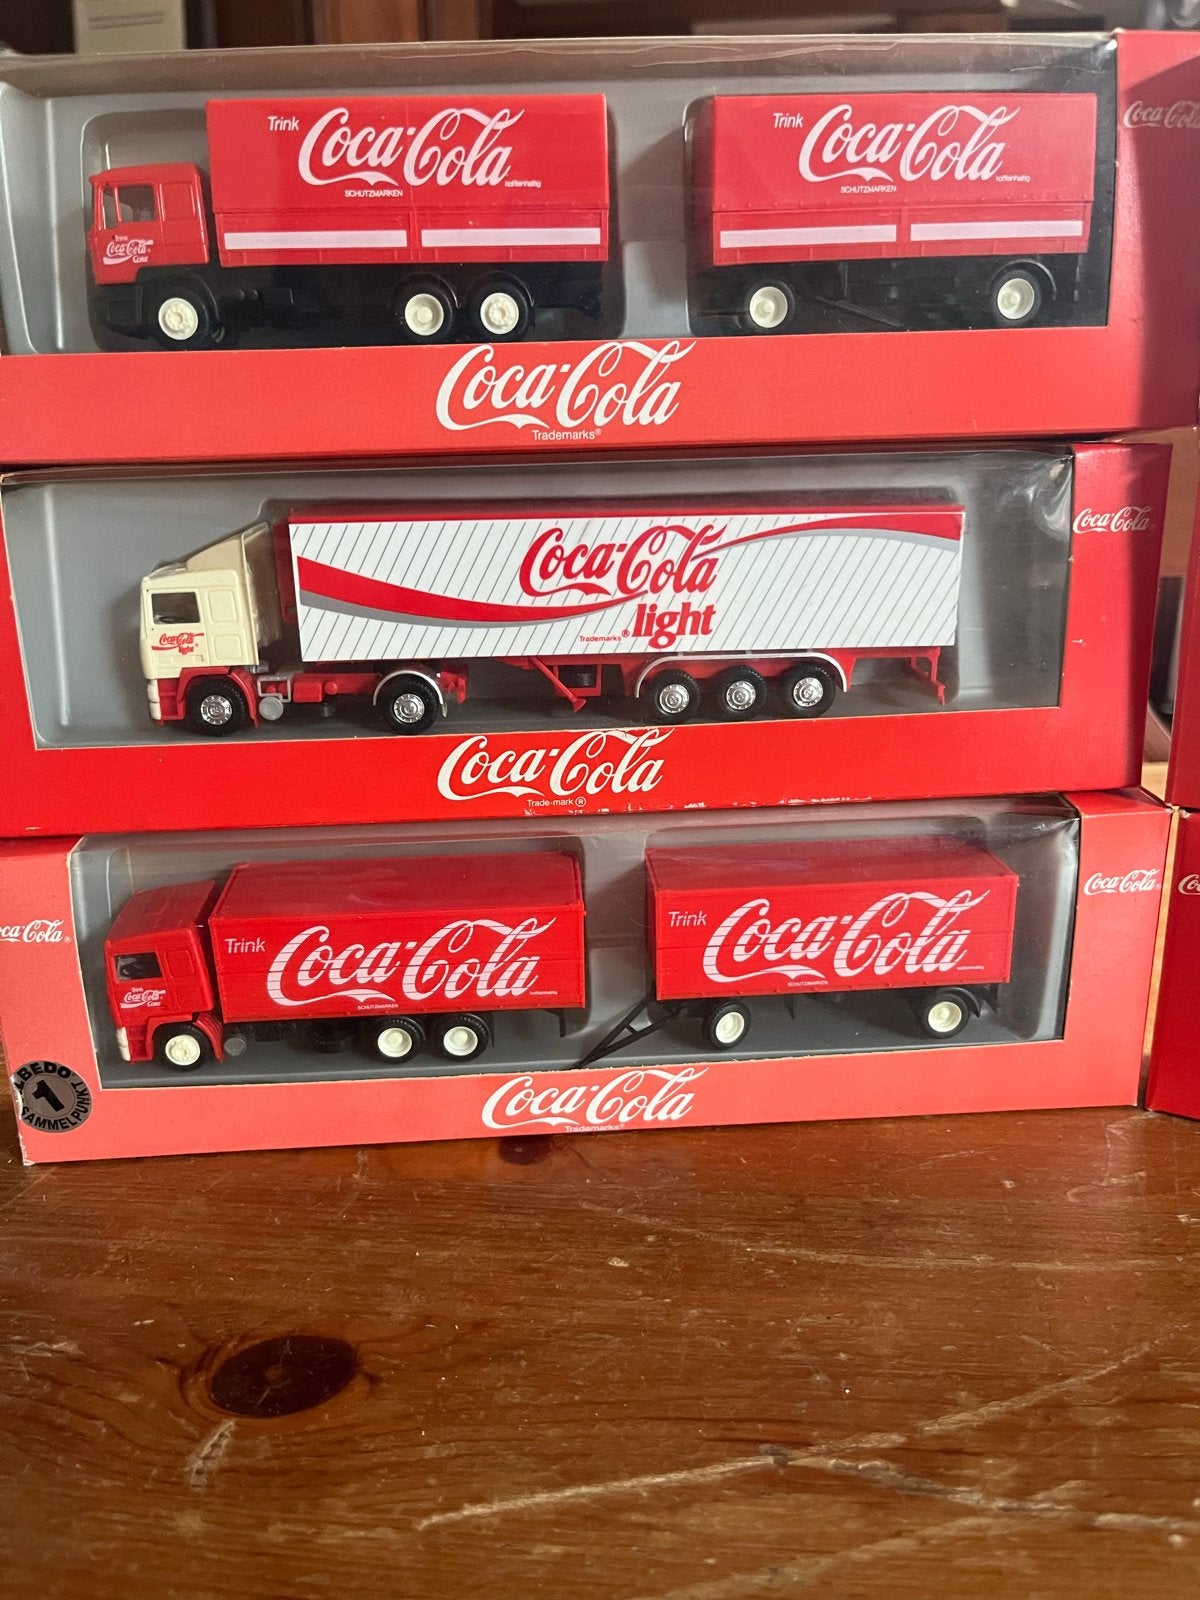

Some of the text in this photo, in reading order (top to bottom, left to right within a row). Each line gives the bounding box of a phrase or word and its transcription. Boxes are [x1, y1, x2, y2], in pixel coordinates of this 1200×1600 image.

[267, 107, 525, 186] Trink Coca-Cola
[773, 104, 1021, 182] Trink Coca-Cola
[344, 189, 403, 198] SCHUTZMARKEN
[840, 185, 897, 194] SCHUTZMARKEN
[106, 239, 153, 258] Coca-Cola
[435, 339, 697, 431] Coca-Cola
[1072, 506, 1153, 534] Coca-Cola
[519, 524, 727, 597] Coca-Cola
[631, 601, 717, 649] light
[437, 728, 675, 801] Coca-Cola
[1083, 868, 1160, 896] Coca-Cola
[0, 919, 64, 943] ca-Cola
[668, 889, 991, 984] Trink Coca-Cola
[224, 917, 557, 1007] Trink Coca-Cola
[32, 1080, 66, 1112] 1
[481, 1067, 710, 1129] Coca-Cola
